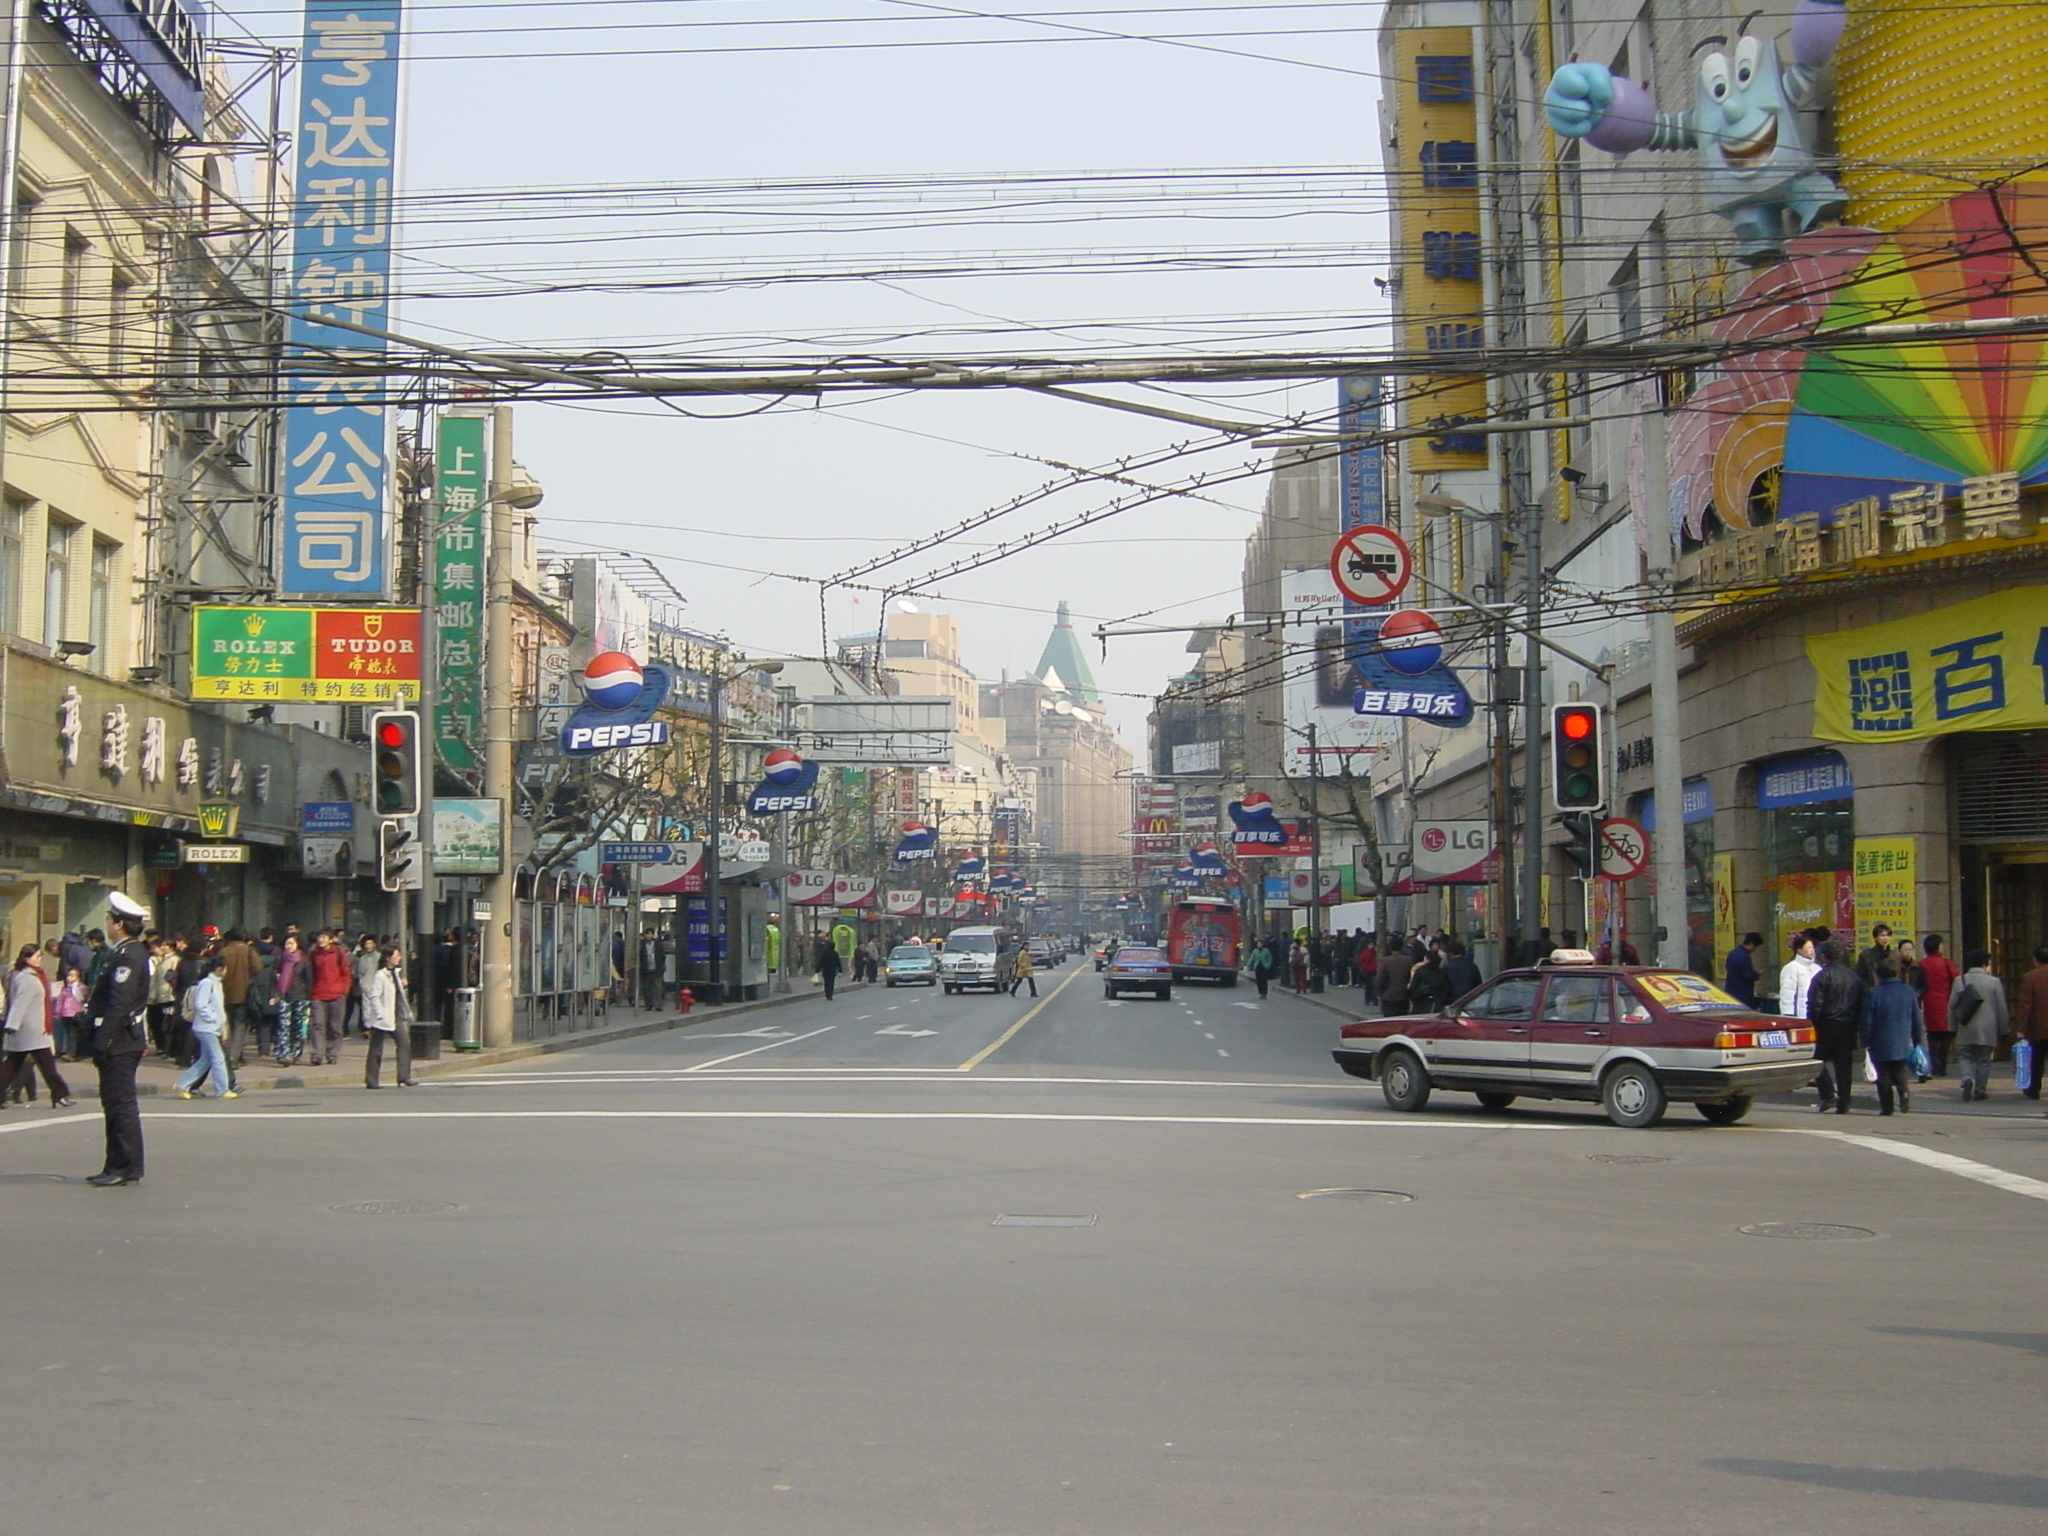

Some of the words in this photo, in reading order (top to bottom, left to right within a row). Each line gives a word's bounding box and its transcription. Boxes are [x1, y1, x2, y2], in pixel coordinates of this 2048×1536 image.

[131, 0, 206, 91] IZEN
[439, 445, 477, 740] 上海市集邮总公司
[213, 639, 295, 655] ROLEX
[331, 638, 415, 653] TUDOR
[1929, 627, 2048, 721] 百
[214, 680, 279, 696] 亨达利
[300, 682, 415, 698] 特约经销商
[1361, 690, 1457, 715] 百事可乐
[570, 722, 662, 750] PEPSI
[753, 795, 814, 812] PEPSI
[1234, 831, 1281, 843] 百事可乐
[1452, 830, 1484, 850] LG
[191, 849, 239, 859] ROLEX
[898, 849, 935, 860] PEPSI
[804, 875, 824, 887] LG
[957, 873, 984, 881] PEPSI
[850, 882, 867, 892] LG
[902, 894, 915, 903] LG
[1184, 934, 1225, 951] 512
